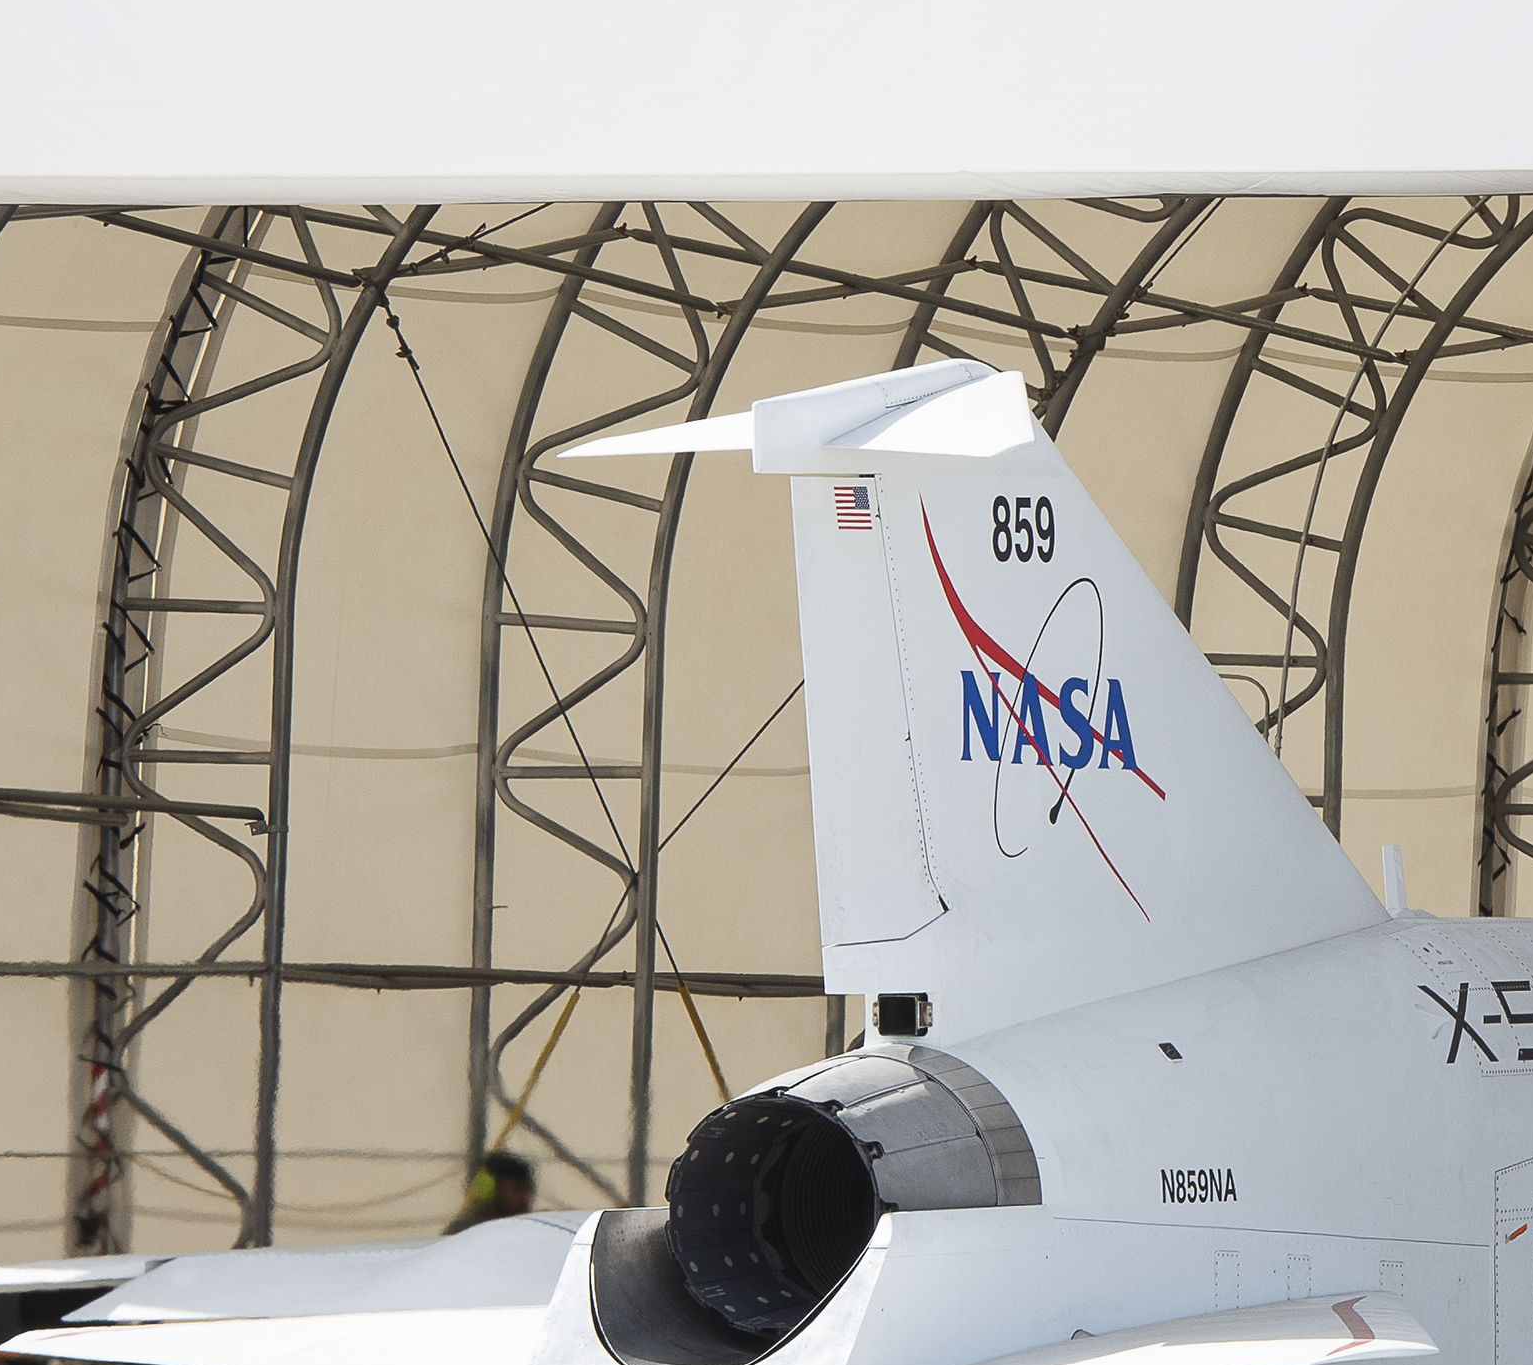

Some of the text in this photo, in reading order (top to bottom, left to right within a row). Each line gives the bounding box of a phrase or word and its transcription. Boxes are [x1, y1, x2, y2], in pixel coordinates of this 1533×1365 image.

[992, 496, 1055, 563] 859
[959, 669, 1138, 771] NASA
[1160, 1168, 1237, 1204] N859NA
